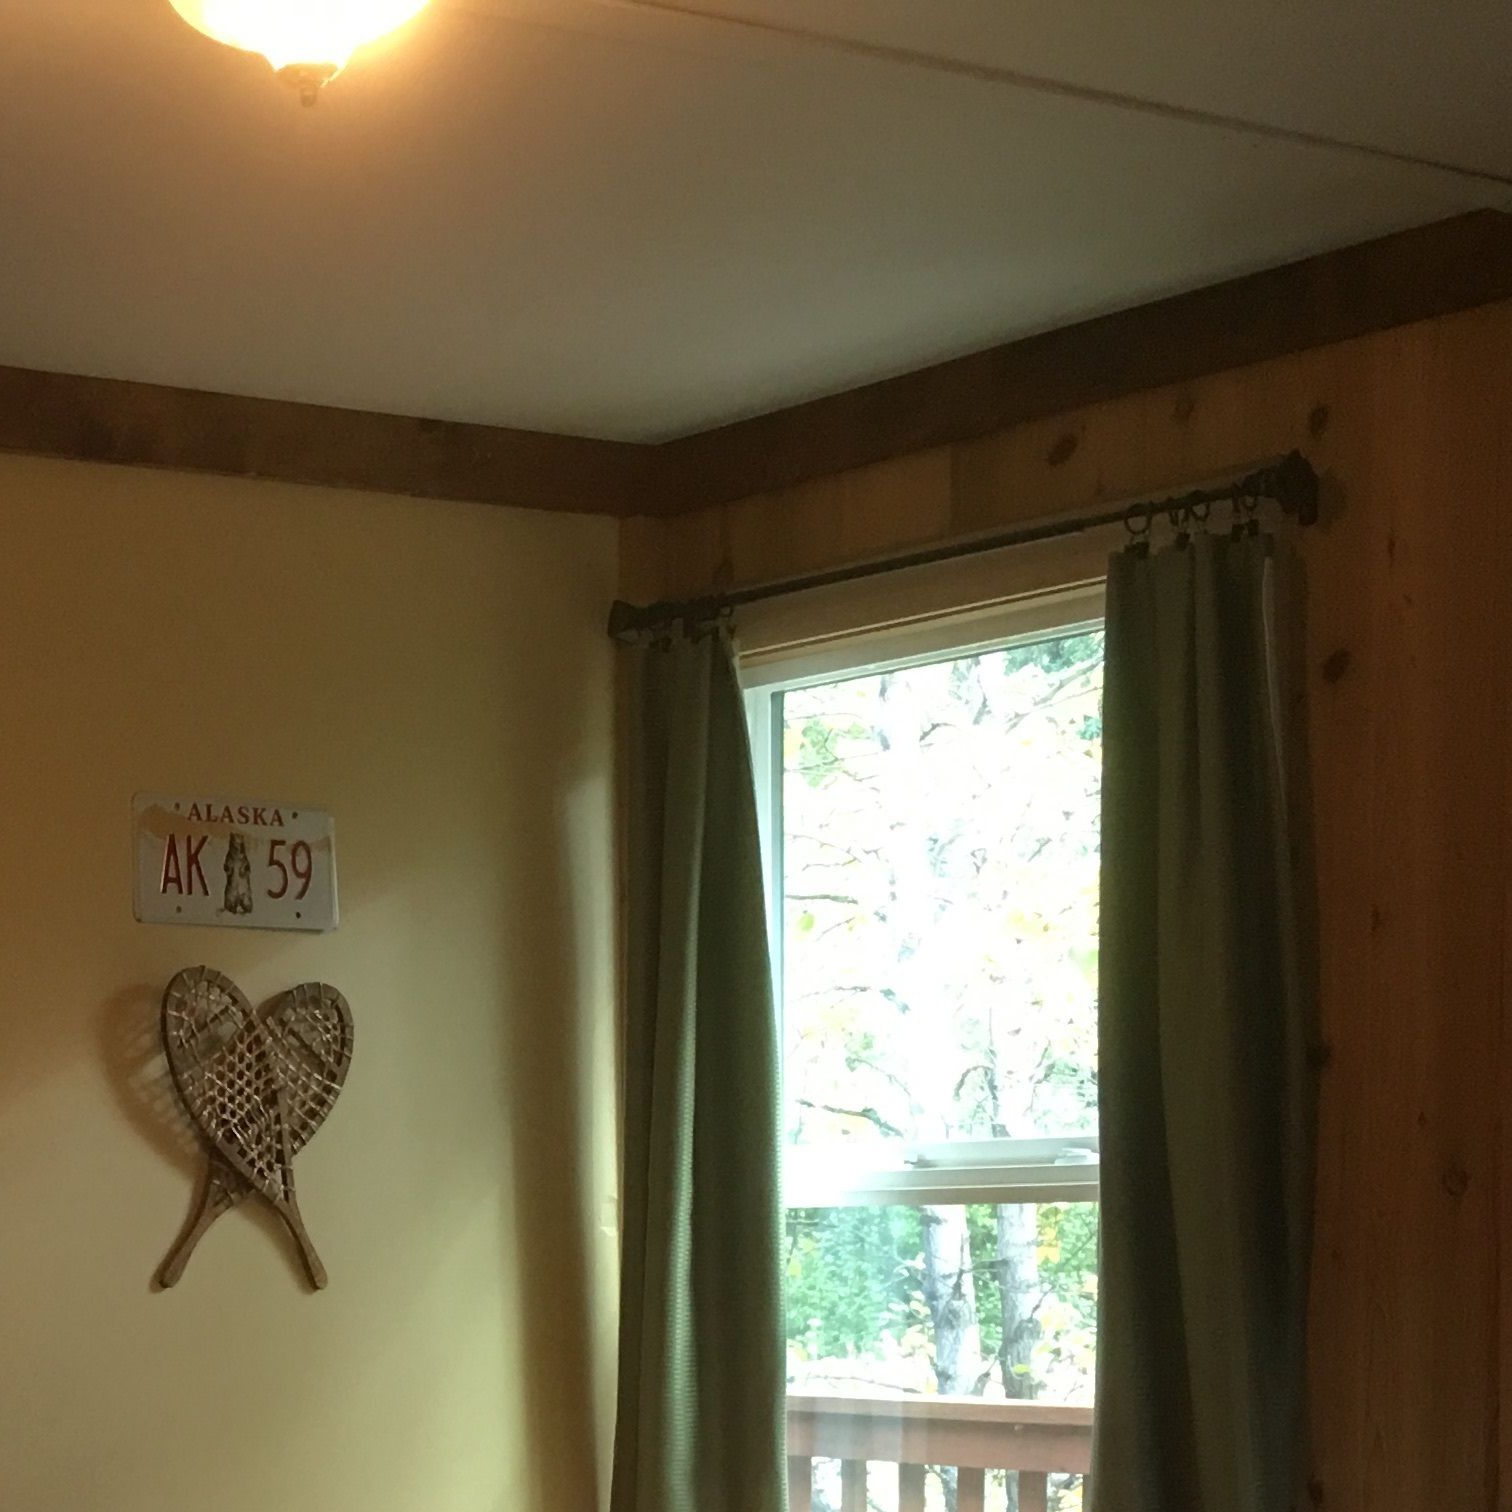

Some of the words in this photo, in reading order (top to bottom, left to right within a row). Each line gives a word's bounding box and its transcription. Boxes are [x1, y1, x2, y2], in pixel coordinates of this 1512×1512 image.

[187, 802, 285, 827] ALASKA
[161, 834, 210, 896] AK
[266, 839, 313, 900] 59
